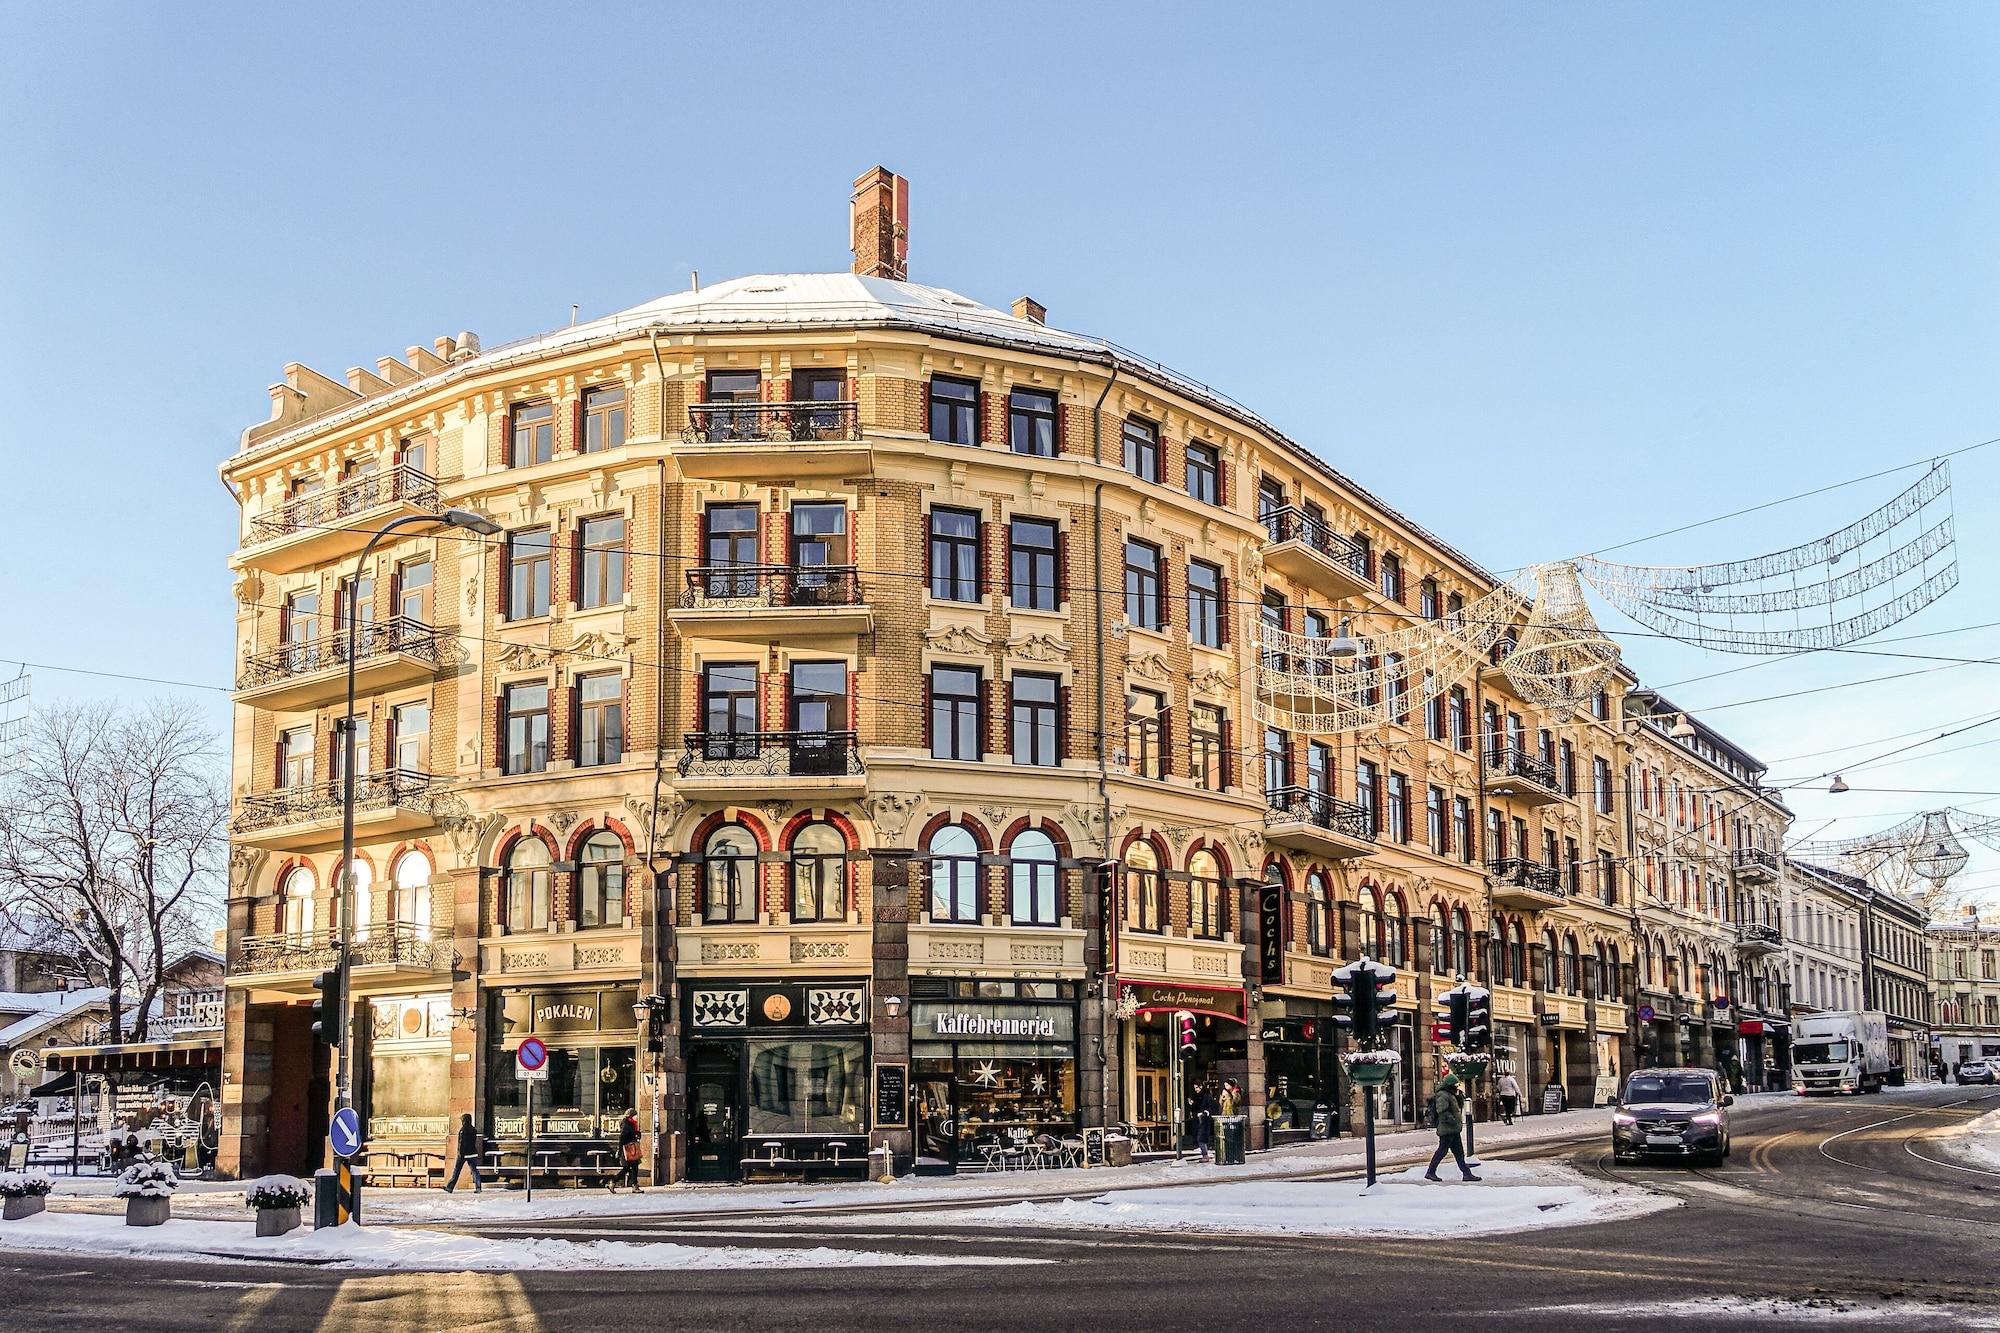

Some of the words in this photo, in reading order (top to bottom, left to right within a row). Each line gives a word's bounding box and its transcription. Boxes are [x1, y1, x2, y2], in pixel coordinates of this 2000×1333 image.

[1263, 893, 1278, 969] Cochs
[1152, 990, 1176, 1002] Cochs
[1176, 991, 1214, 1006] Pensjonat
[536, 1004, 594, 1022] POKALEN
[936, 1012, 1056, 1037] Kaffebrenneriet
[1596, 1087, 1616, 1097] 70%
[497, 1120, 524, 1133] SPORT
[547, 1120, 580, 1133] MUSIKK
[608, 1120, 621, 1132] BA
